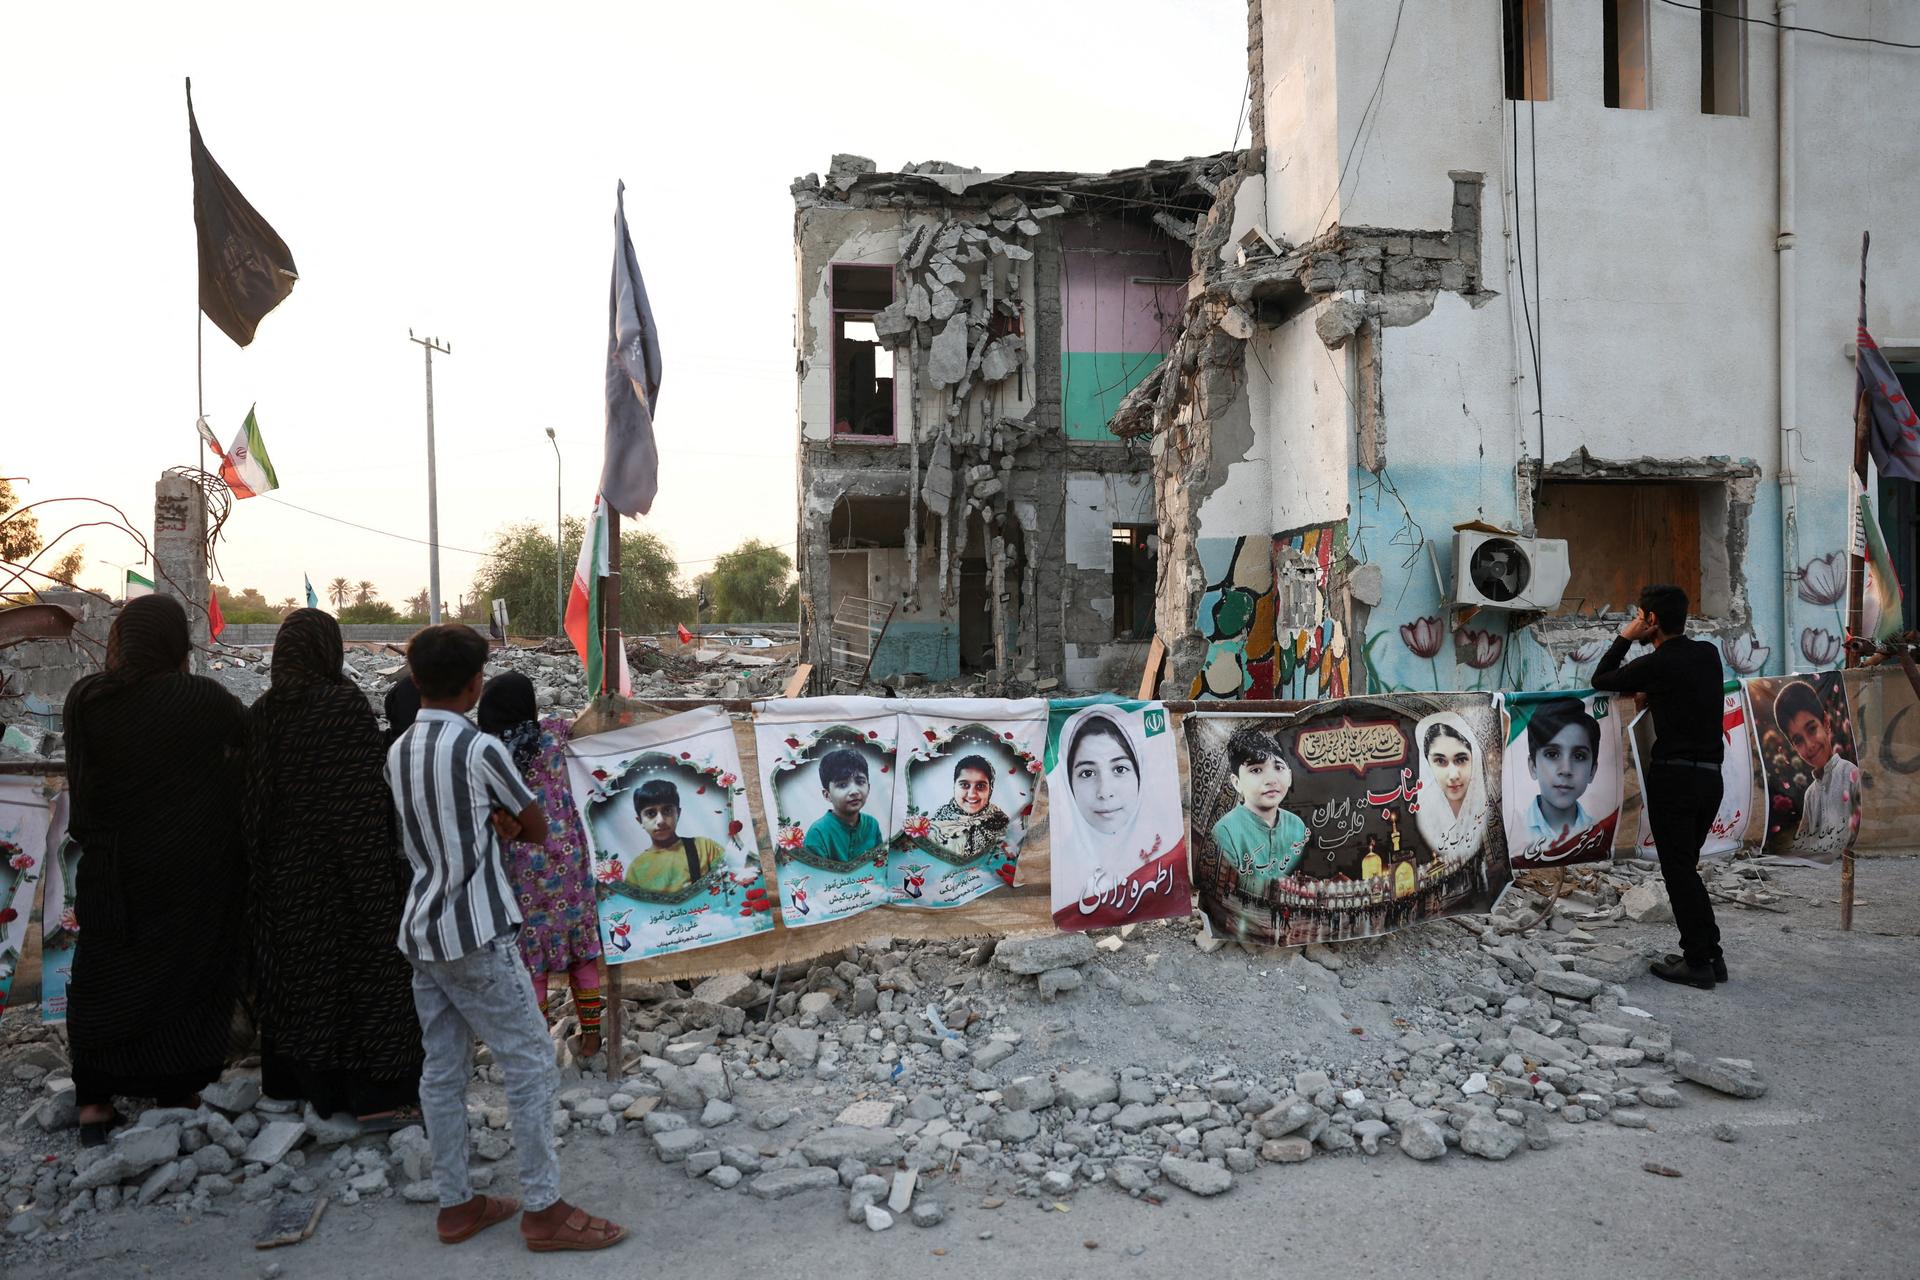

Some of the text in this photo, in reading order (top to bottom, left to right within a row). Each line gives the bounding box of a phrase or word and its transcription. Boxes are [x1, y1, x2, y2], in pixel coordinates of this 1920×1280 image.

[1367, 768, 1424, 820] میناب
[1311, 796, 1351, 829] ایران
[1127, 861, 1174, 914] اطهره
[687, 903, 710, 915] شهید
[665, 921, 699, 935] علی زارعی
